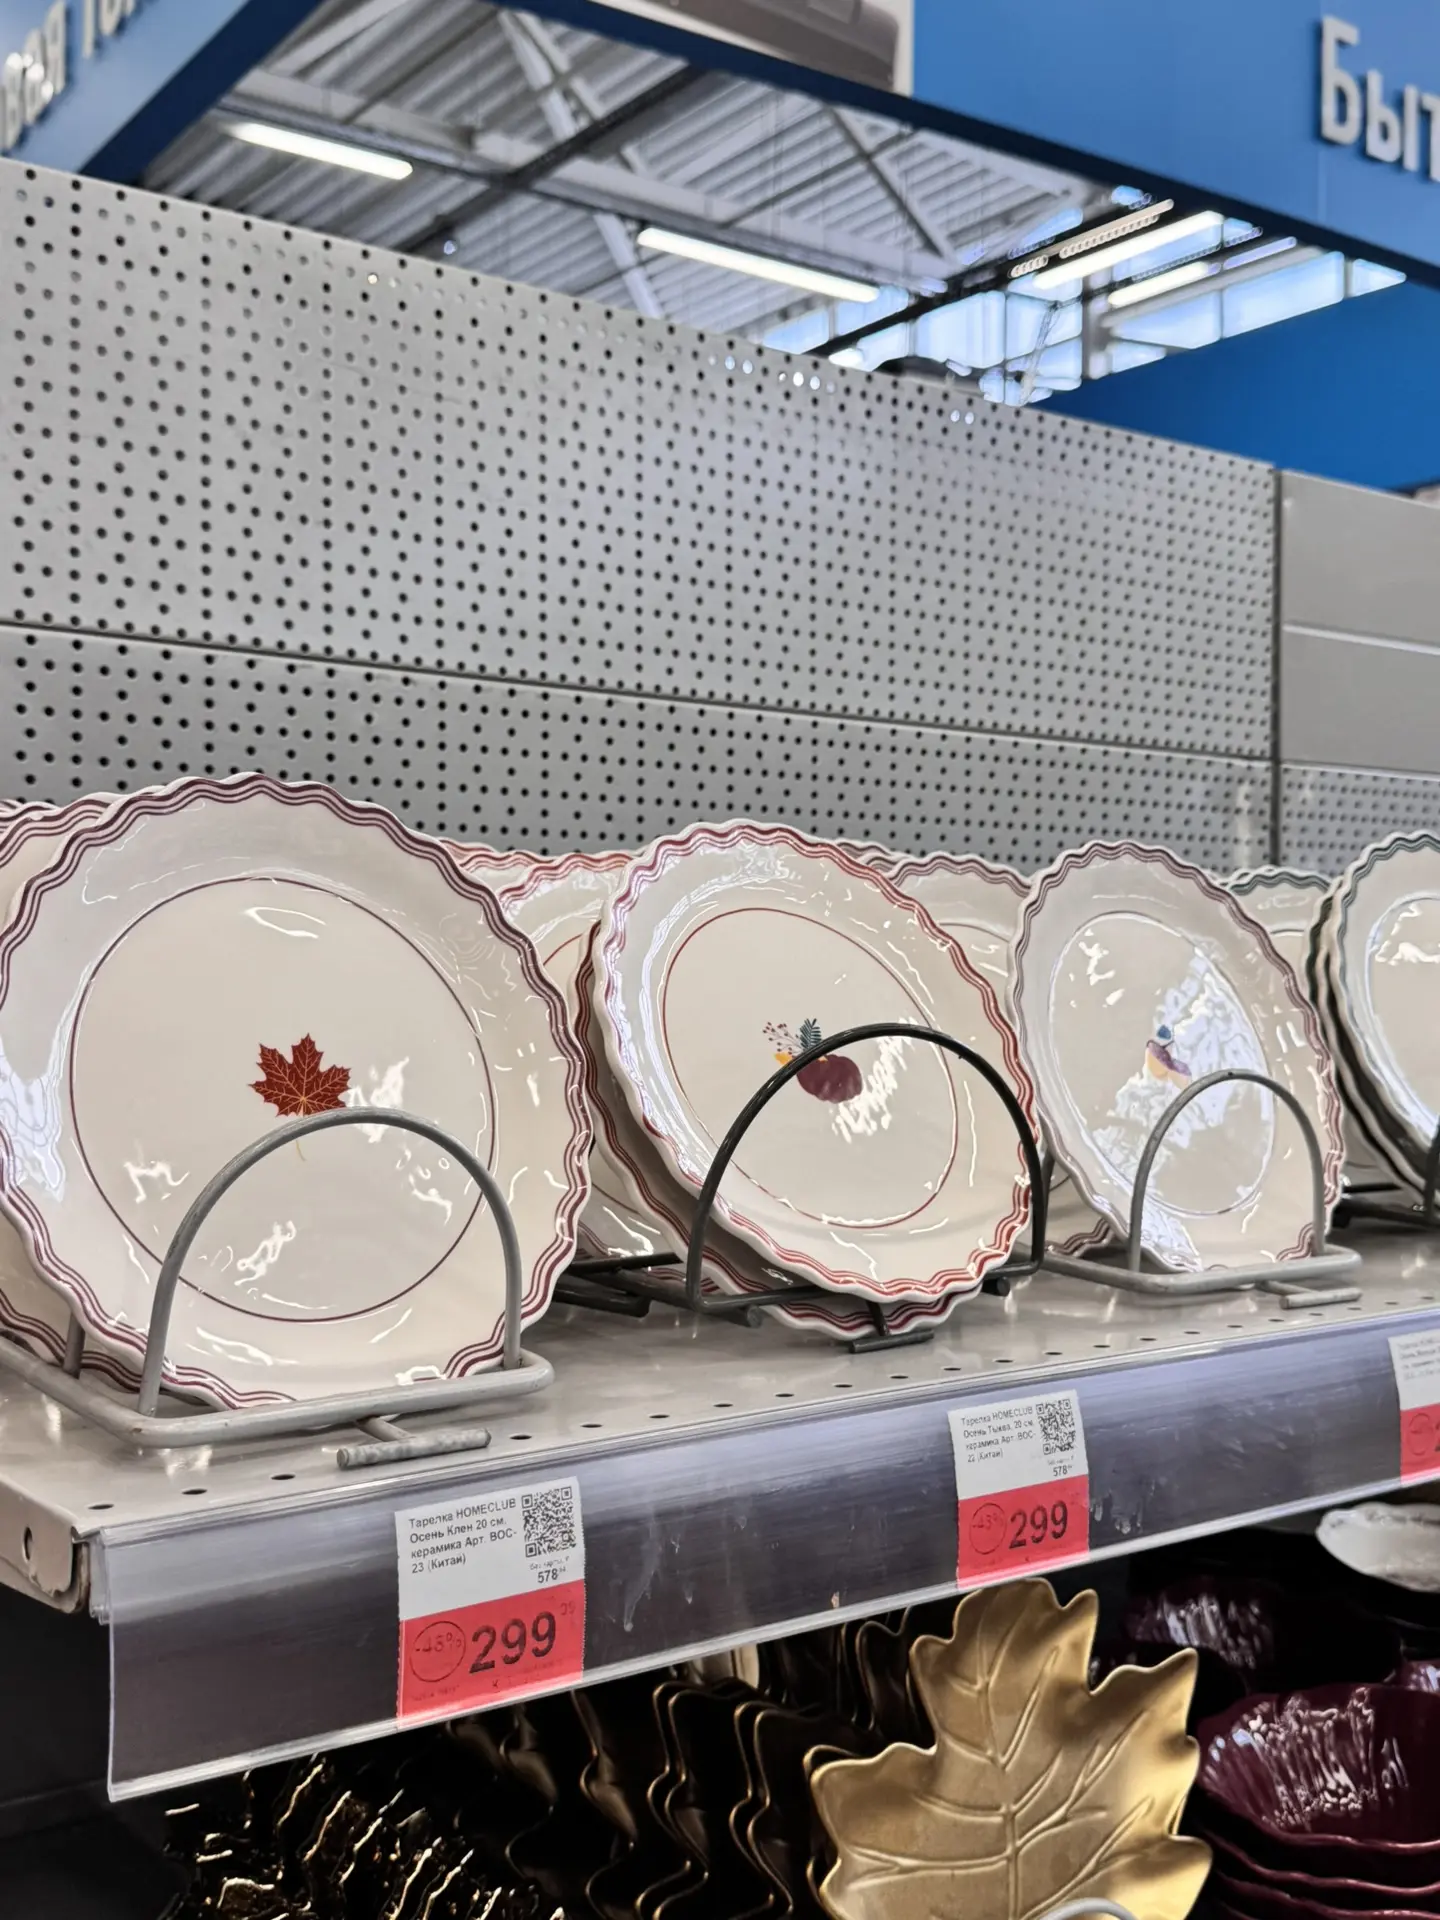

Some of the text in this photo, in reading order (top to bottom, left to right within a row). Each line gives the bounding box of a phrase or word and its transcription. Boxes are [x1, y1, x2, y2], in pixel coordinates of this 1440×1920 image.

[960, 1406, 1033, 1427] Тарелка HOMECLUB
[963, 1428, 987, 1439] Осень
[1013, 1420, 1022, 1429] 20
[966, 1438, 1000, 1451] керамика
[409, 1498, 516, 1529] Тарелка HOMECLUB
[410, 1530, 444, 1544] Осень
[447, 1523, 473, 1536] Клен
[475, 1519, 488, 1531] 20
[1008, 1500, 1069, 1550] 299
[411, 1540, 462, 1559] керамика
[465, 1536, 487, 1548] Арт.
[412, 1553, 466, 1574] 23 (Китай)
[537, 1568, 559, 1583] 578
[468, 1611, 556, 1675] 299
